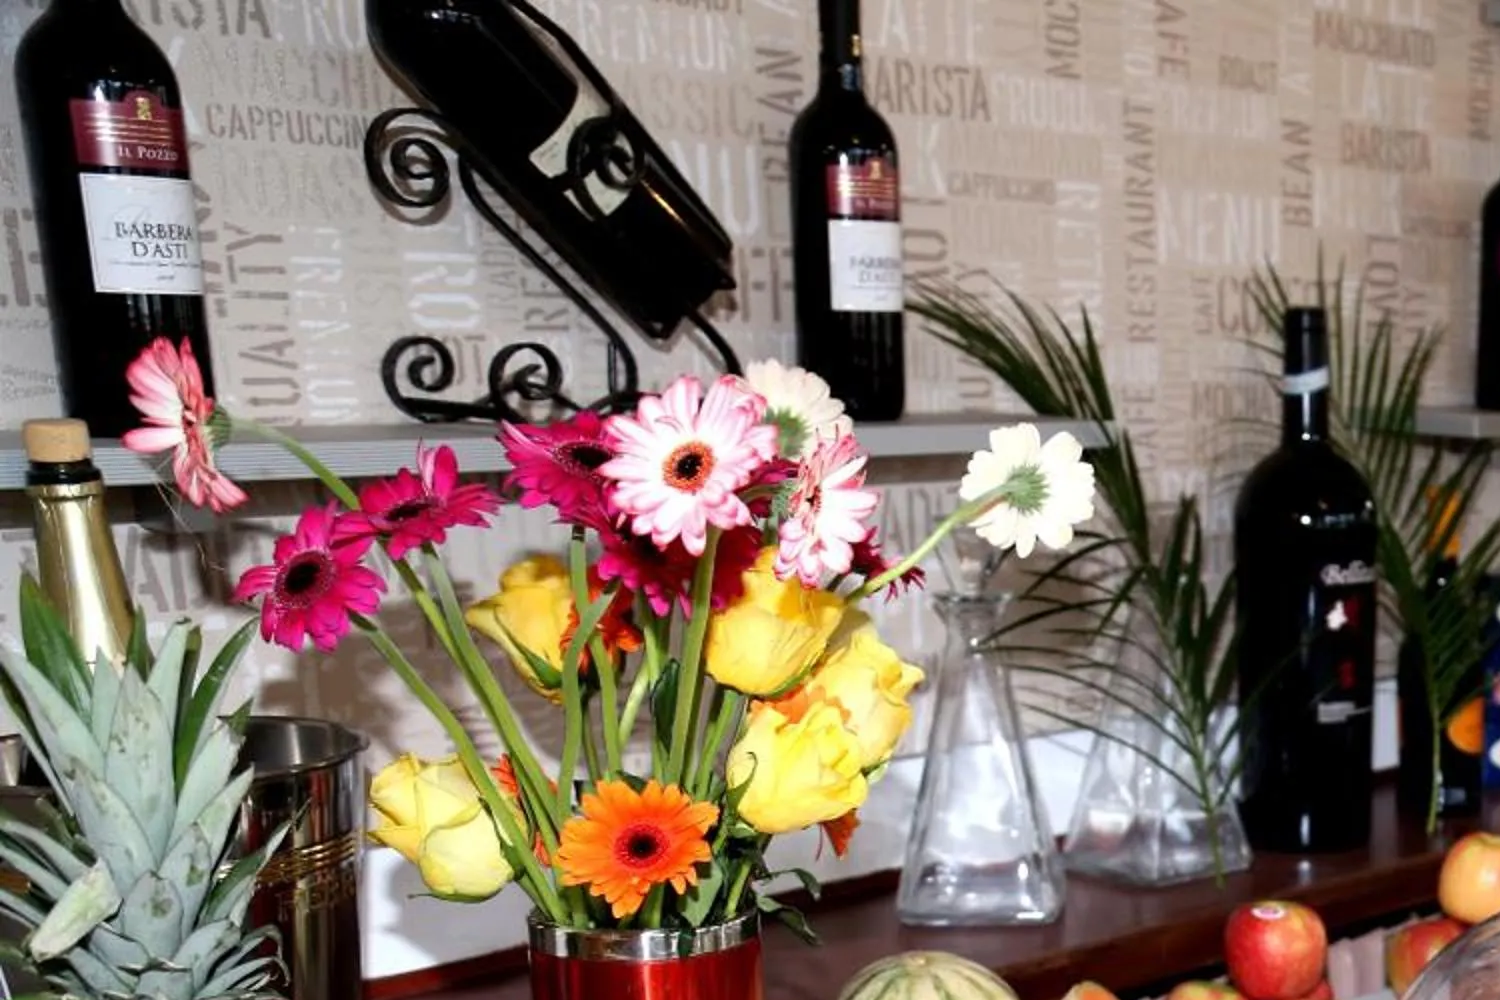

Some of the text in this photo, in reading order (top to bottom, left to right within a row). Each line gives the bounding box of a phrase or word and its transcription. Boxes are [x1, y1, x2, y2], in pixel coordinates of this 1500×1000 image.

[868, 55, 991, 123] ARISTA
[204, 102, 369, 151] CAPPUCCIN
[1281, 117, 1313, 229] BEAN
[114, 221, 194, 241] BARBERA
[1122, 97, 1156, 345] RESTAURANT
